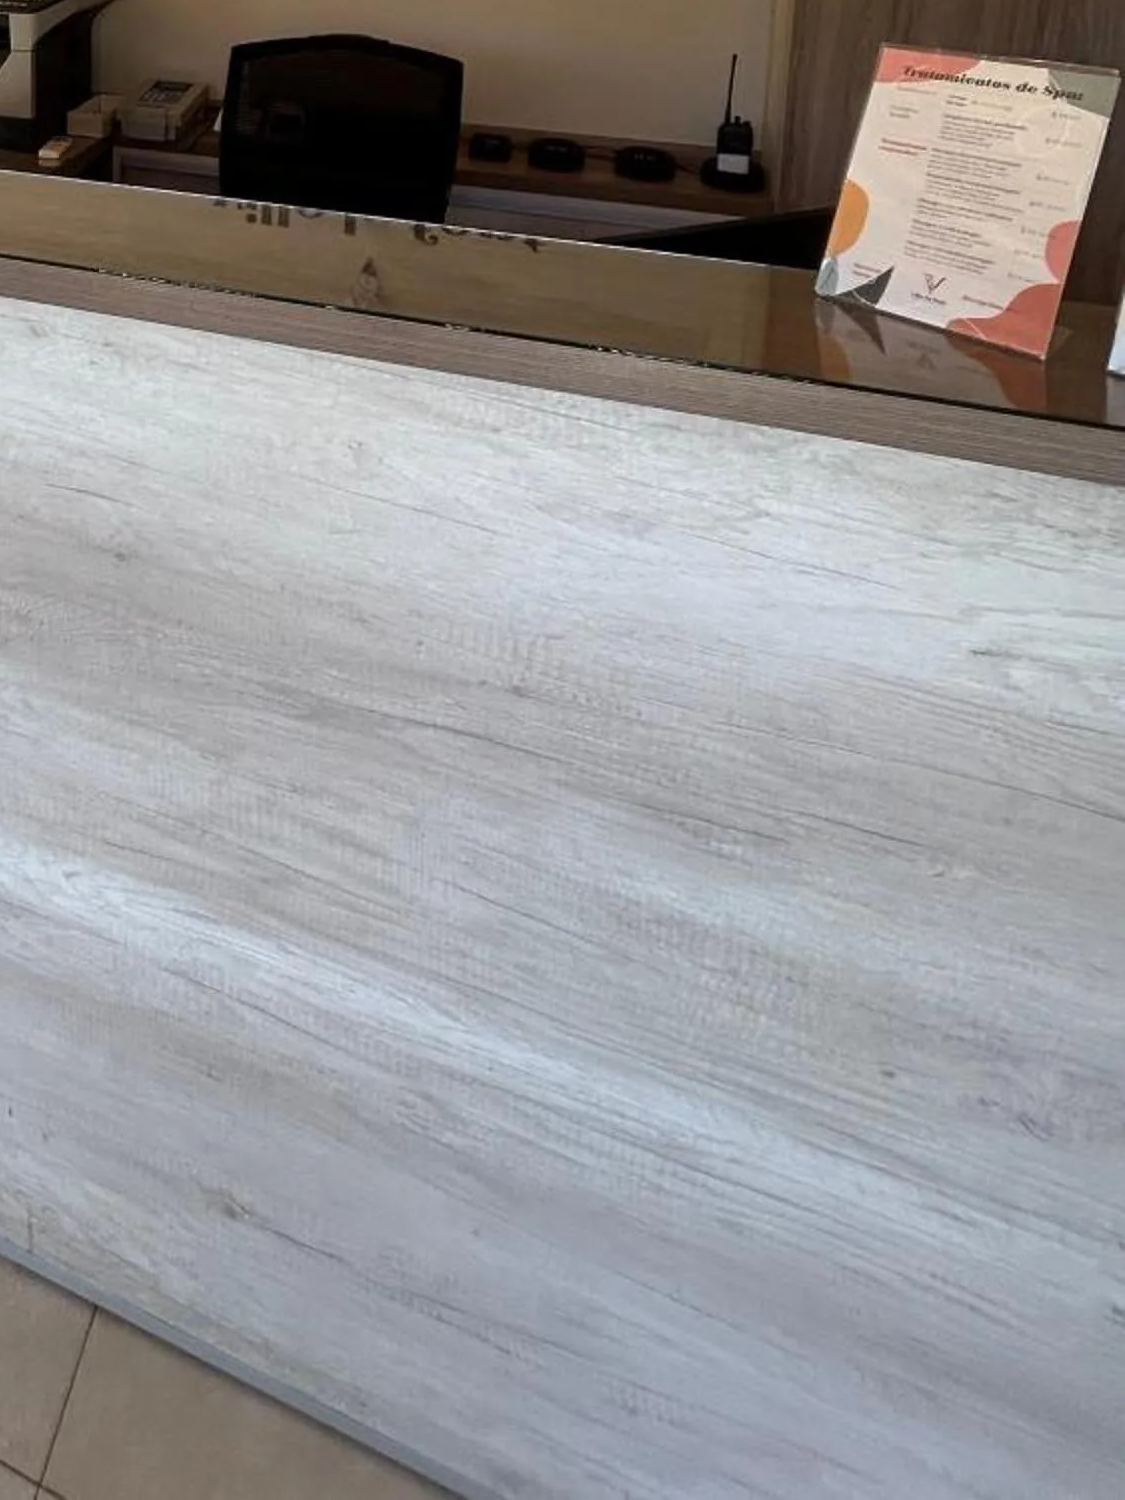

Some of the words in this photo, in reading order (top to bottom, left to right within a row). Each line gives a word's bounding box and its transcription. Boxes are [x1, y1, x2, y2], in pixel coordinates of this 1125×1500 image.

[903, 66, 1011, 92] Tratamientos
[1015, 83, 1039, 94] de
[1042, 85, 1085, 101] Spa
